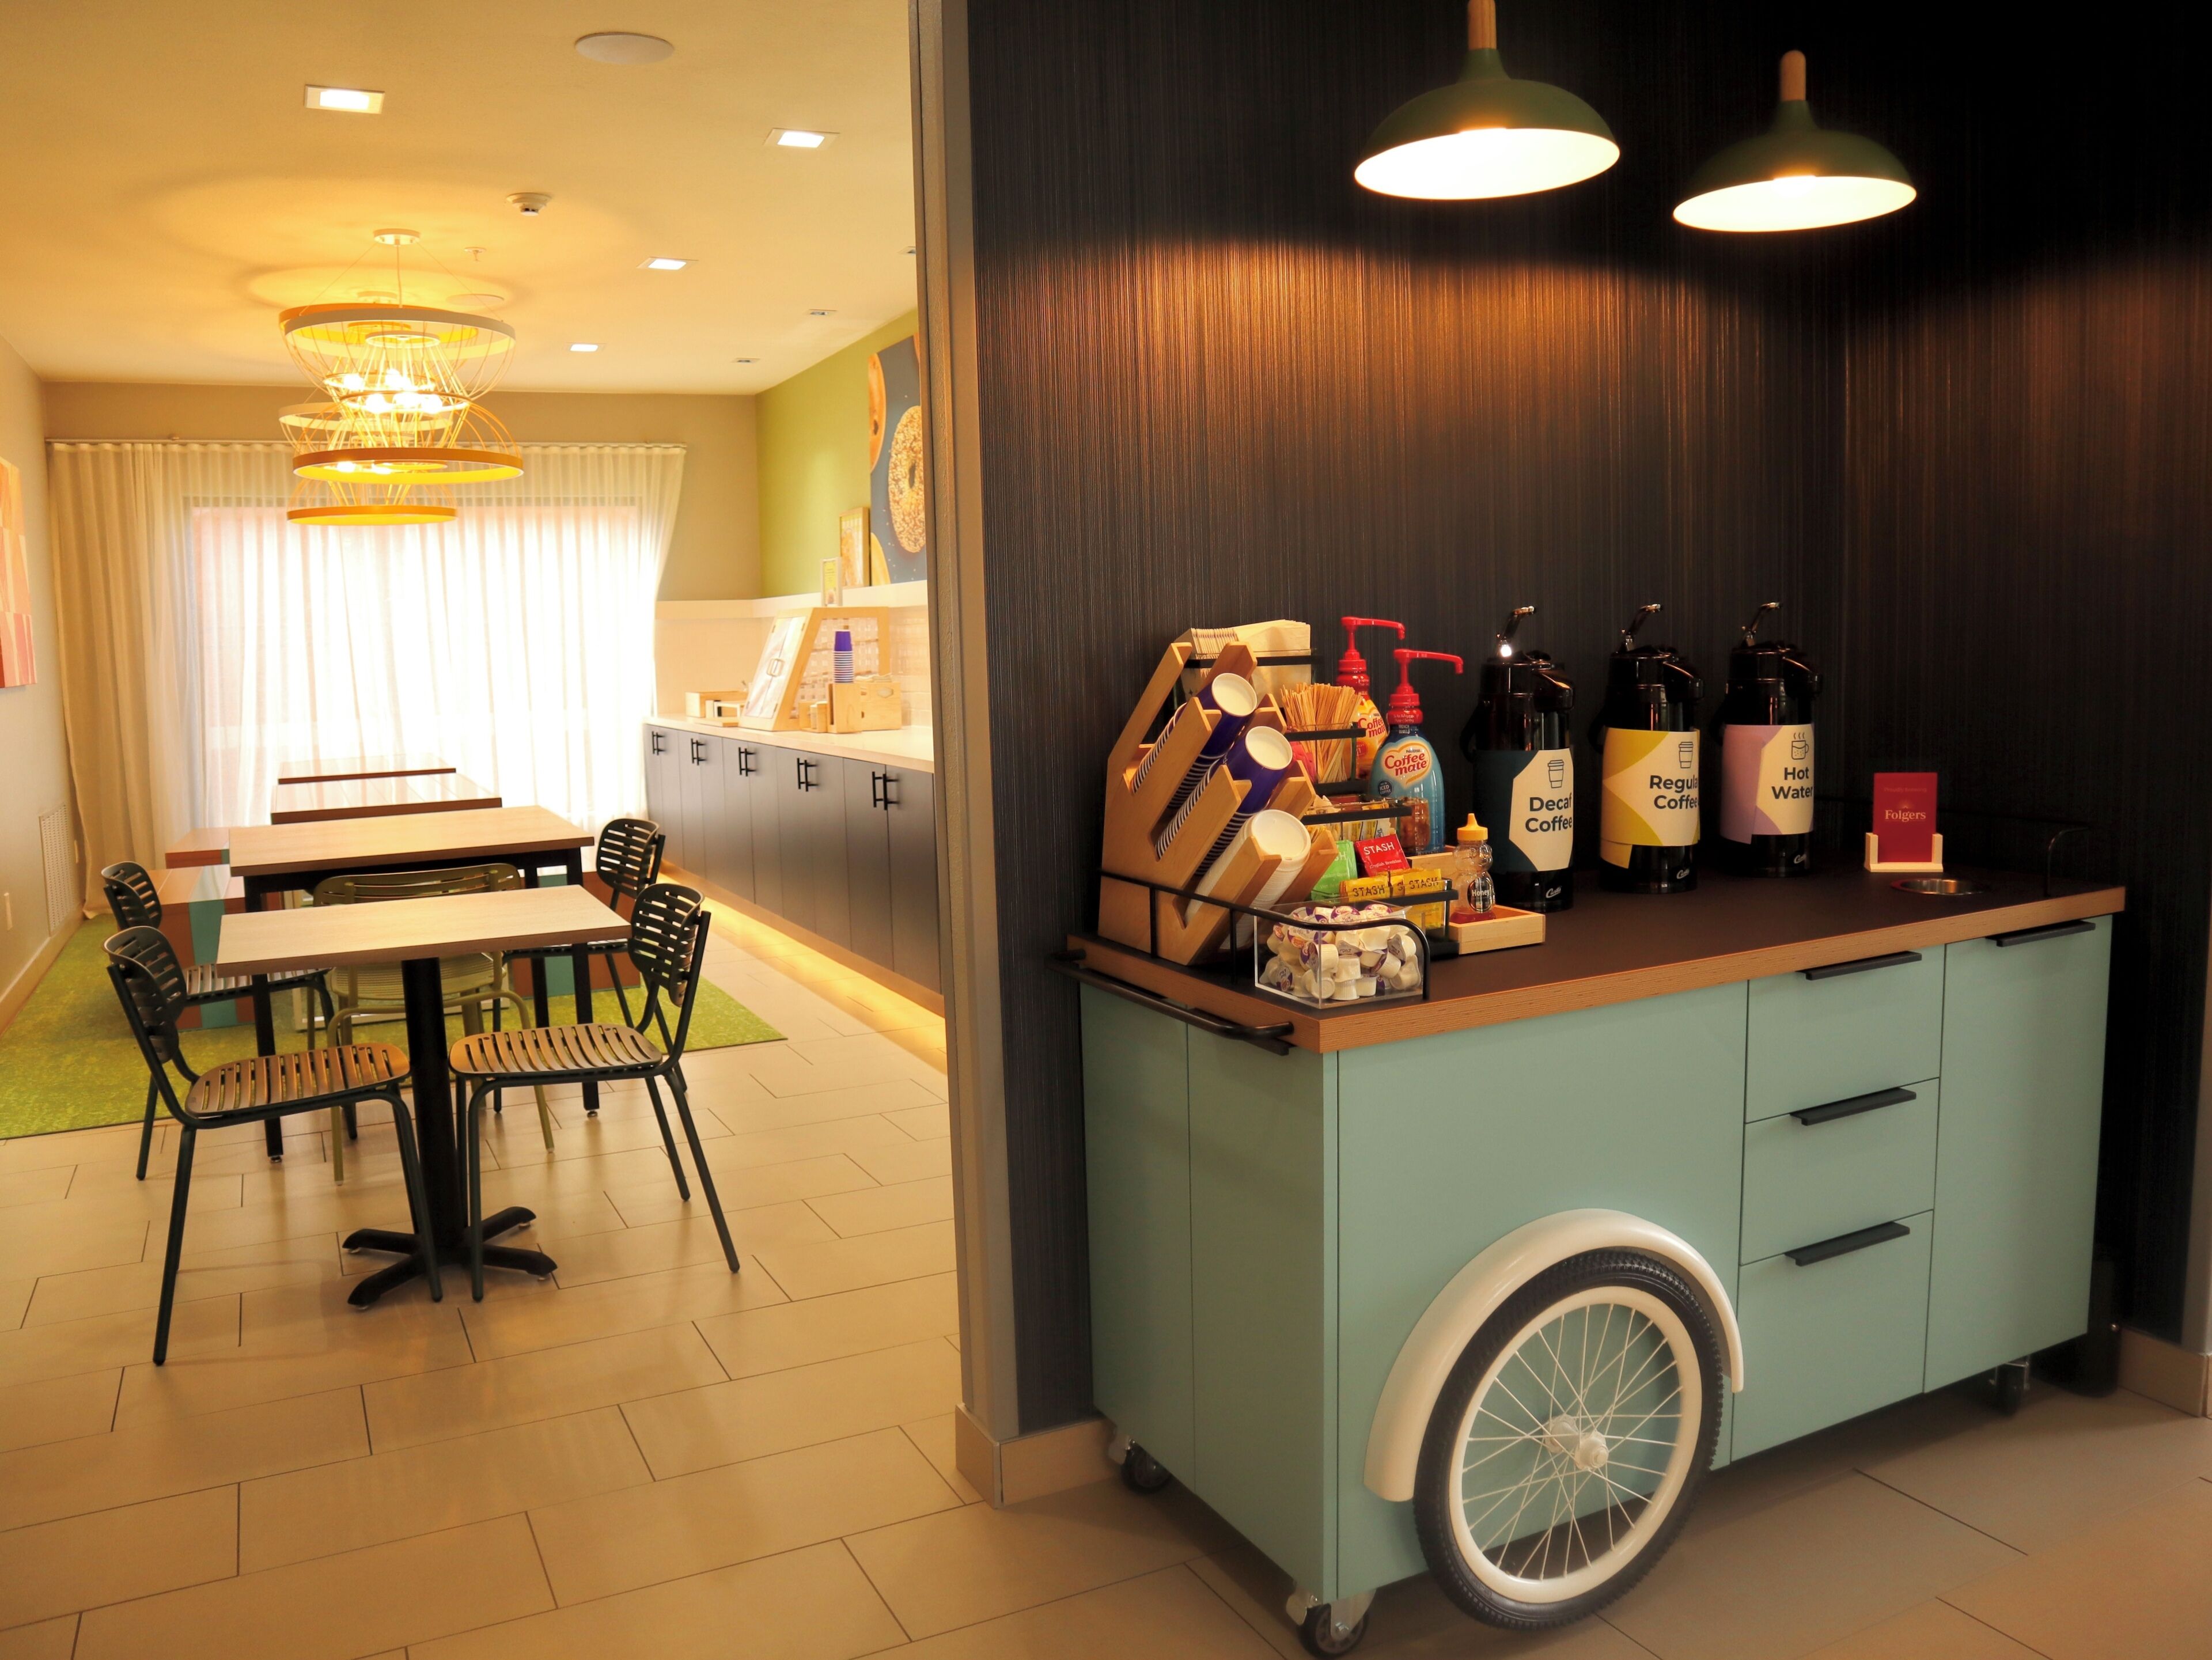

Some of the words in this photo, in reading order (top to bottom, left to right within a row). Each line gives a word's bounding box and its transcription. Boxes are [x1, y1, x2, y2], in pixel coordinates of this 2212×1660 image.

[1384, 753, 1425, 769] Coffee
[1395, 760, 1427, 776] mate
[1784, 767, 1809, 780] Hot
[1650, 774, 1698, 793] Regula
[1771, 786, 1813, 799] Water
[1529, 792, 1572, 812] Decaf
[1654, 794, 1698, 809] Coffee
[1885, 810, 1926, 823] Folgers
[1525, 816, 1573, 833] Coffee
[1363, 842, 1395, 855] STASH
[1409, 877, 1438, 889] STASH
[1352, 885, 1385, 897] STASH
